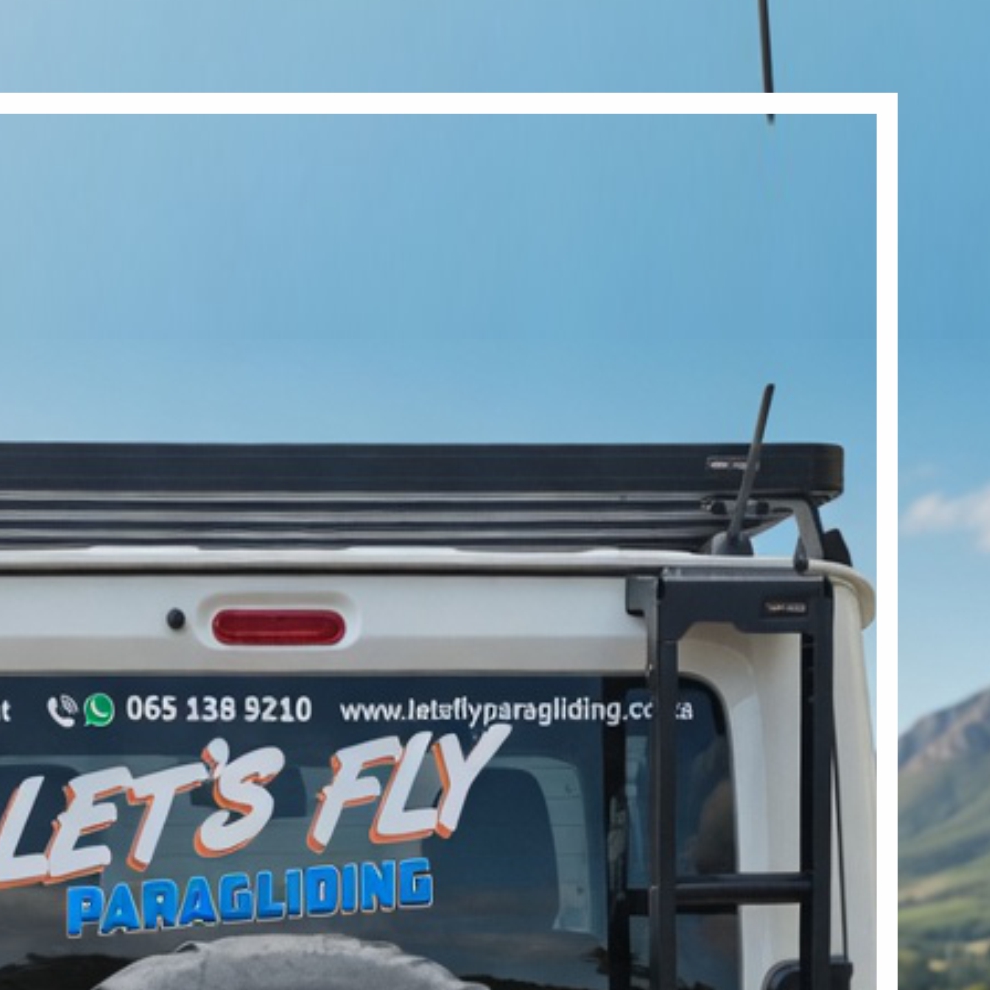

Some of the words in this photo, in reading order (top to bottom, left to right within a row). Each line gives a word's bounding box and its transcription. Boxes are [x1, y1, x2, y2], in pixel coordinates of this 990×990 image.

[126, 694, 177, 722] 065
[186, 695, 236, 723] 138
[244, 696, 312, 723] 9210
[306, 723, 513, 854] FLY
[65, 856, 434, 939] PARAGLIDING
